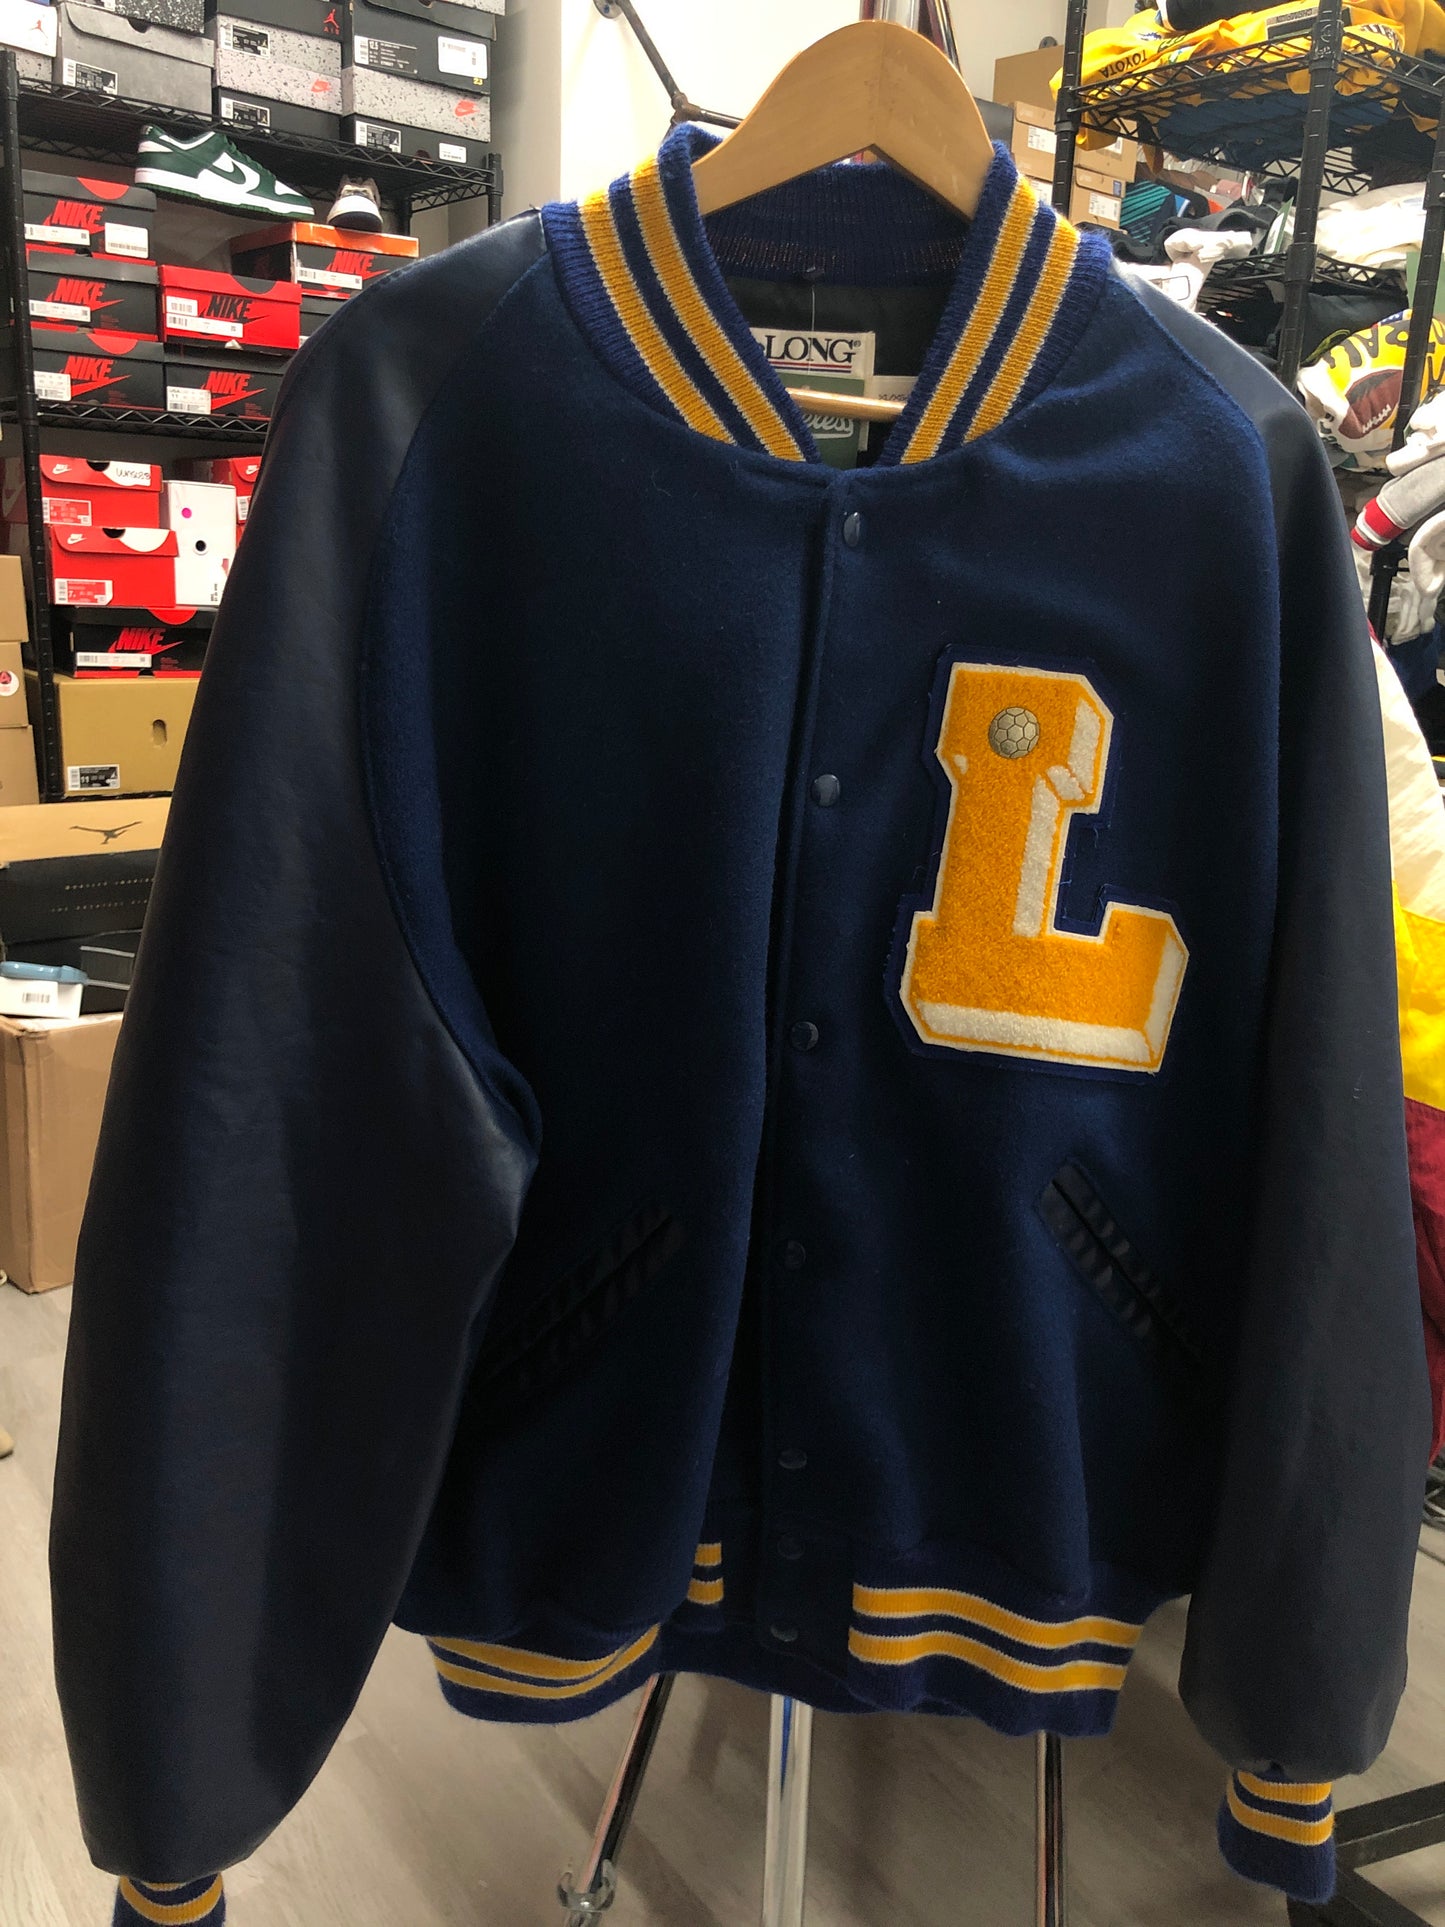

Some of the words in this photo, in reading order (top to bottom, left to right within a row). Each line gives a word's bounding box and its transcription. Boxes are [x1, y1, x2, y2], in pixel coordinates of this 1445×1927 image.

[1100, 49, 1148, 79] TOYOTA
[51, 200, 105, 228] NIKE
[330, 250, 375, 275] NIKE
[53, 278, 106, 305] NIKE
[205, 294, 254, 322] NIKE
[64, 355, 114, 381] NIKE
[205, 371, 251, 394] NIKE
[115, 627, 167, 651] NIKE
[899, 661, 1190, 1073] L
